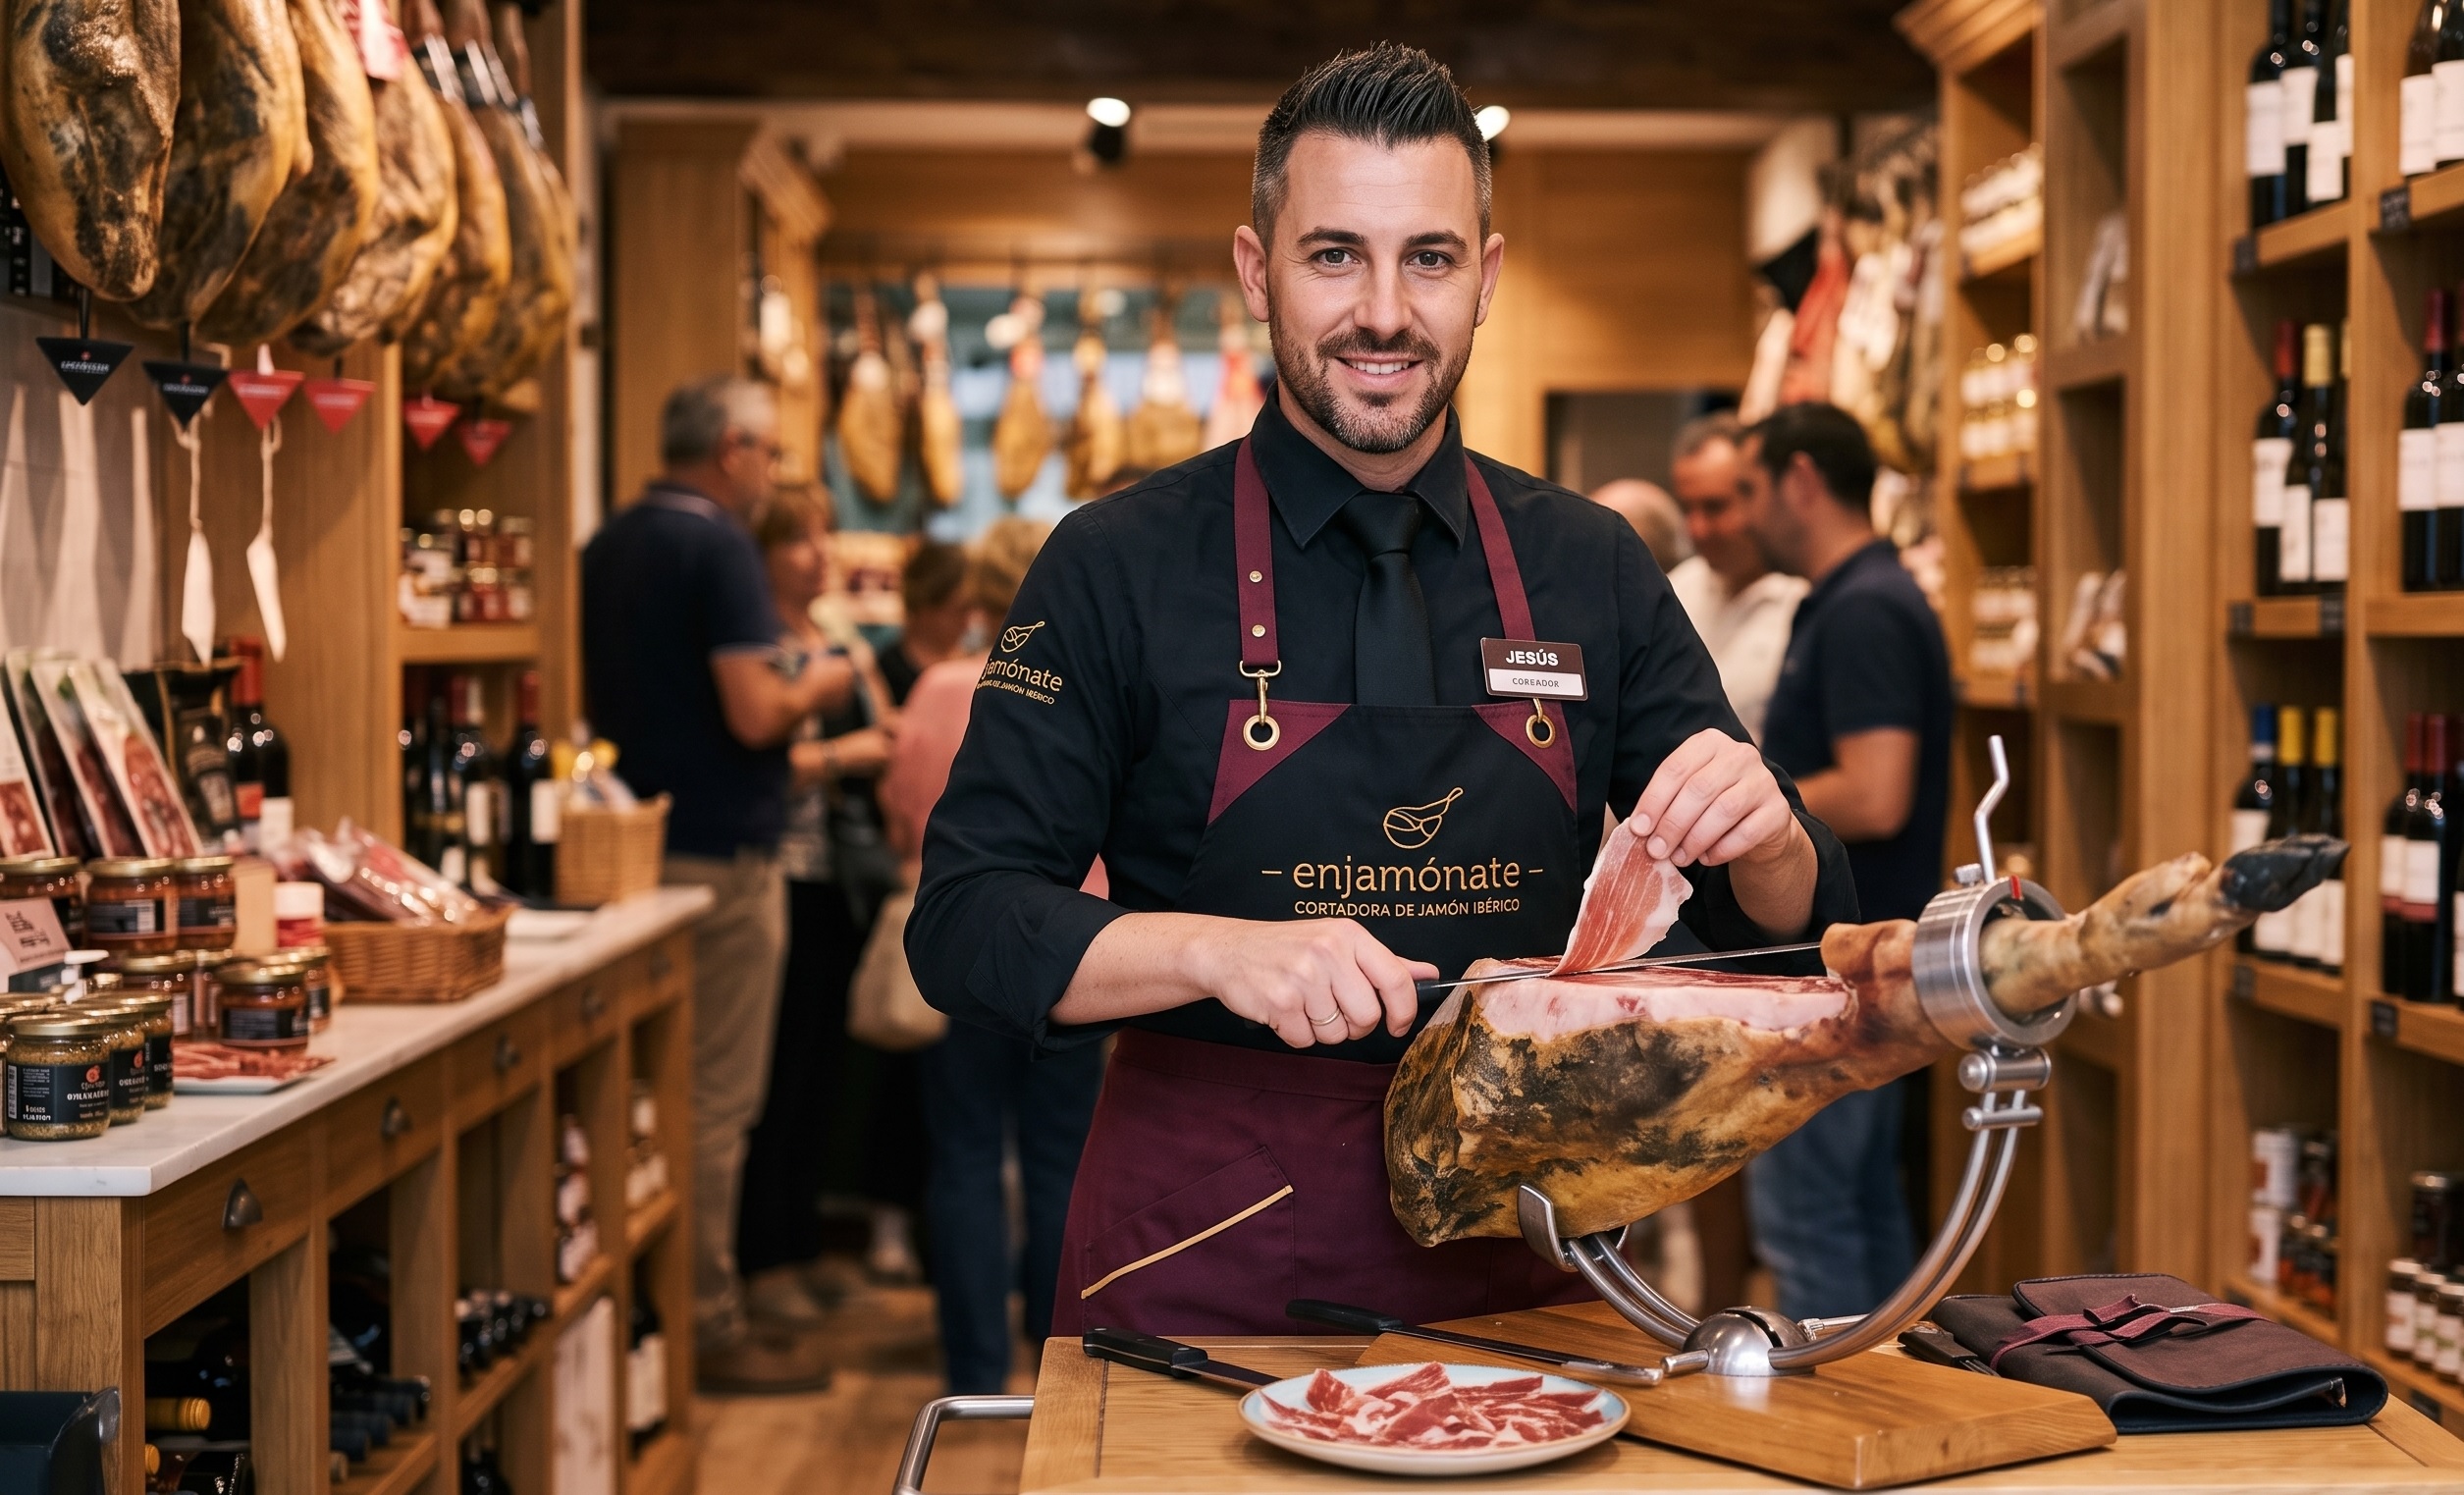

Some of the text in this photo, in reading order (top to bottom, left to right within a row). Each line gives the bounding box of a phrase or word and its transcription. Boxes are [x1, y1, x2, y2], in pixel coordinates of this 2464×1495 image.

[1505, 648, 1559, 667] JESÚS
[1512, 677, 1560, 688] COREADOR
[1292, 855, 1521, 899] enjamónate
[1294, 897, 1521, 918] CORTADORA DE JAMÓN IBÉRICO
